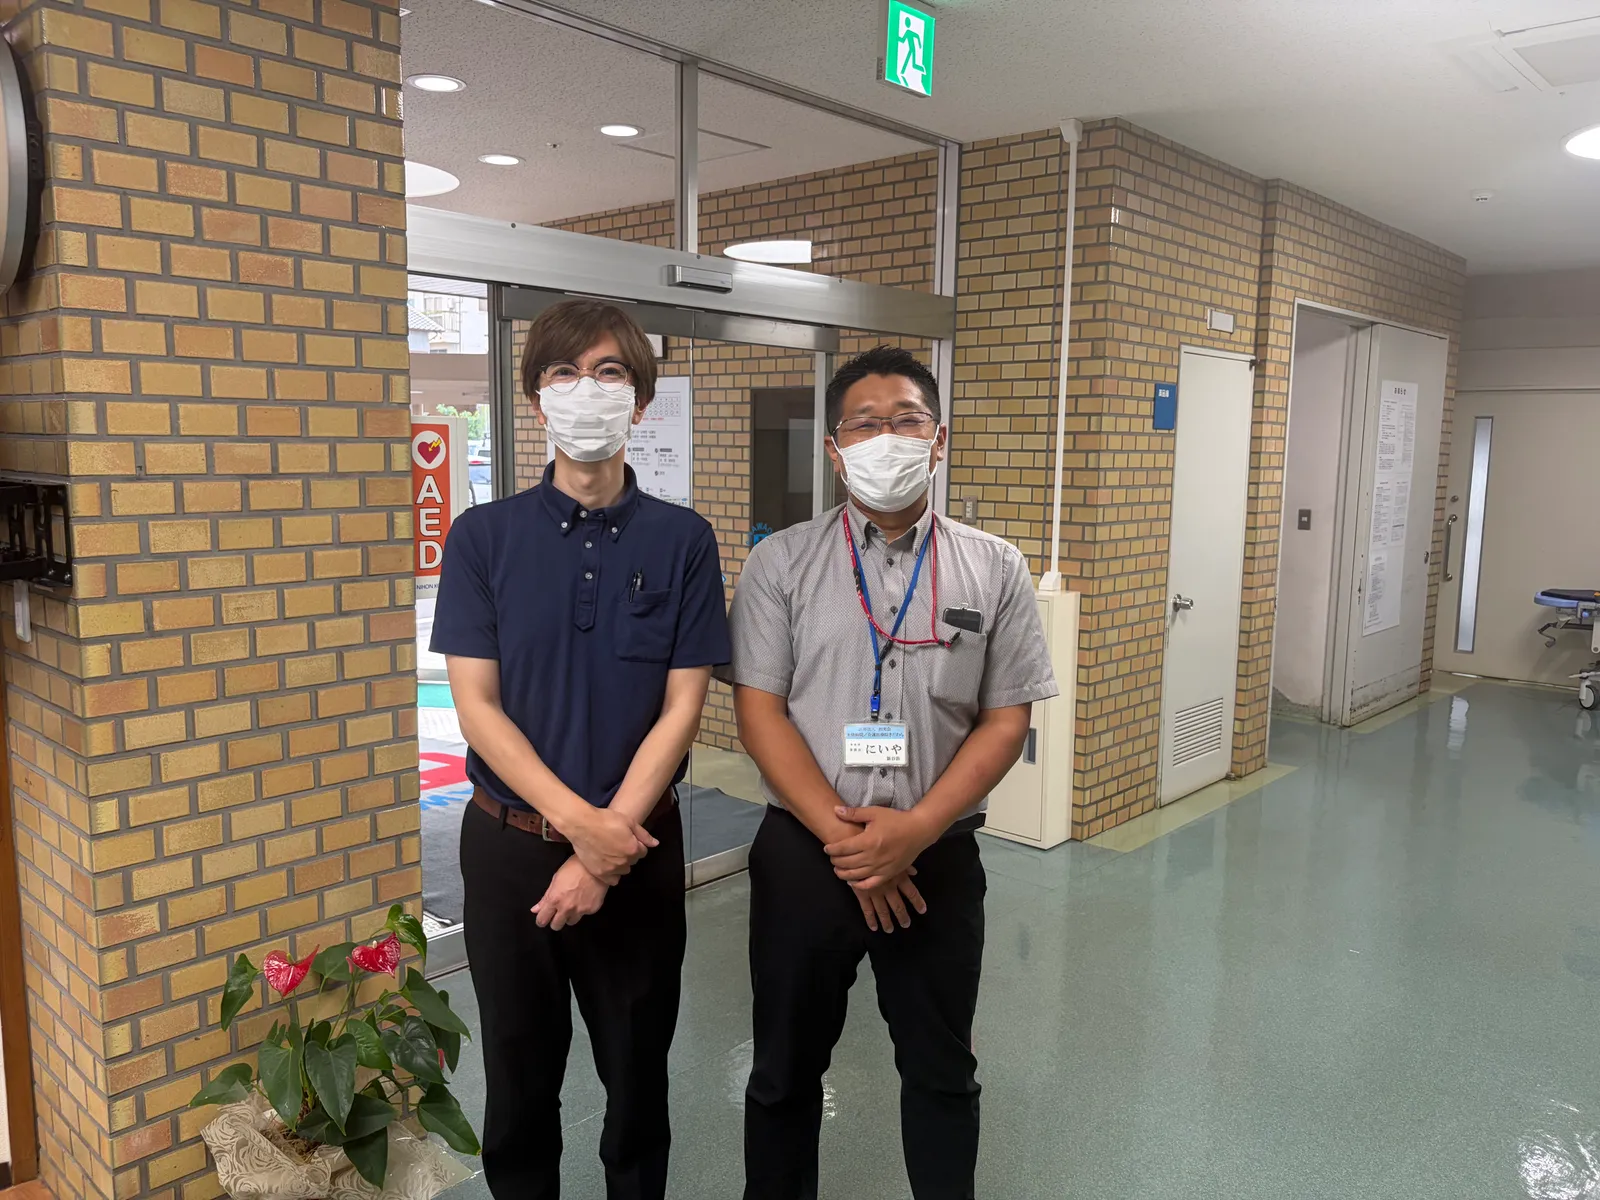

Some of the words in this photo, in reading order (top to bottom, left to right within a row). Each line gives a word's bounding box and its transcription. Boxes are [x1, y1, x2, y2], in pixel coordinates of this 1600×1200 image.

[416, 475, 444, 570] AED
[865, 744, 902, 755] にいや
